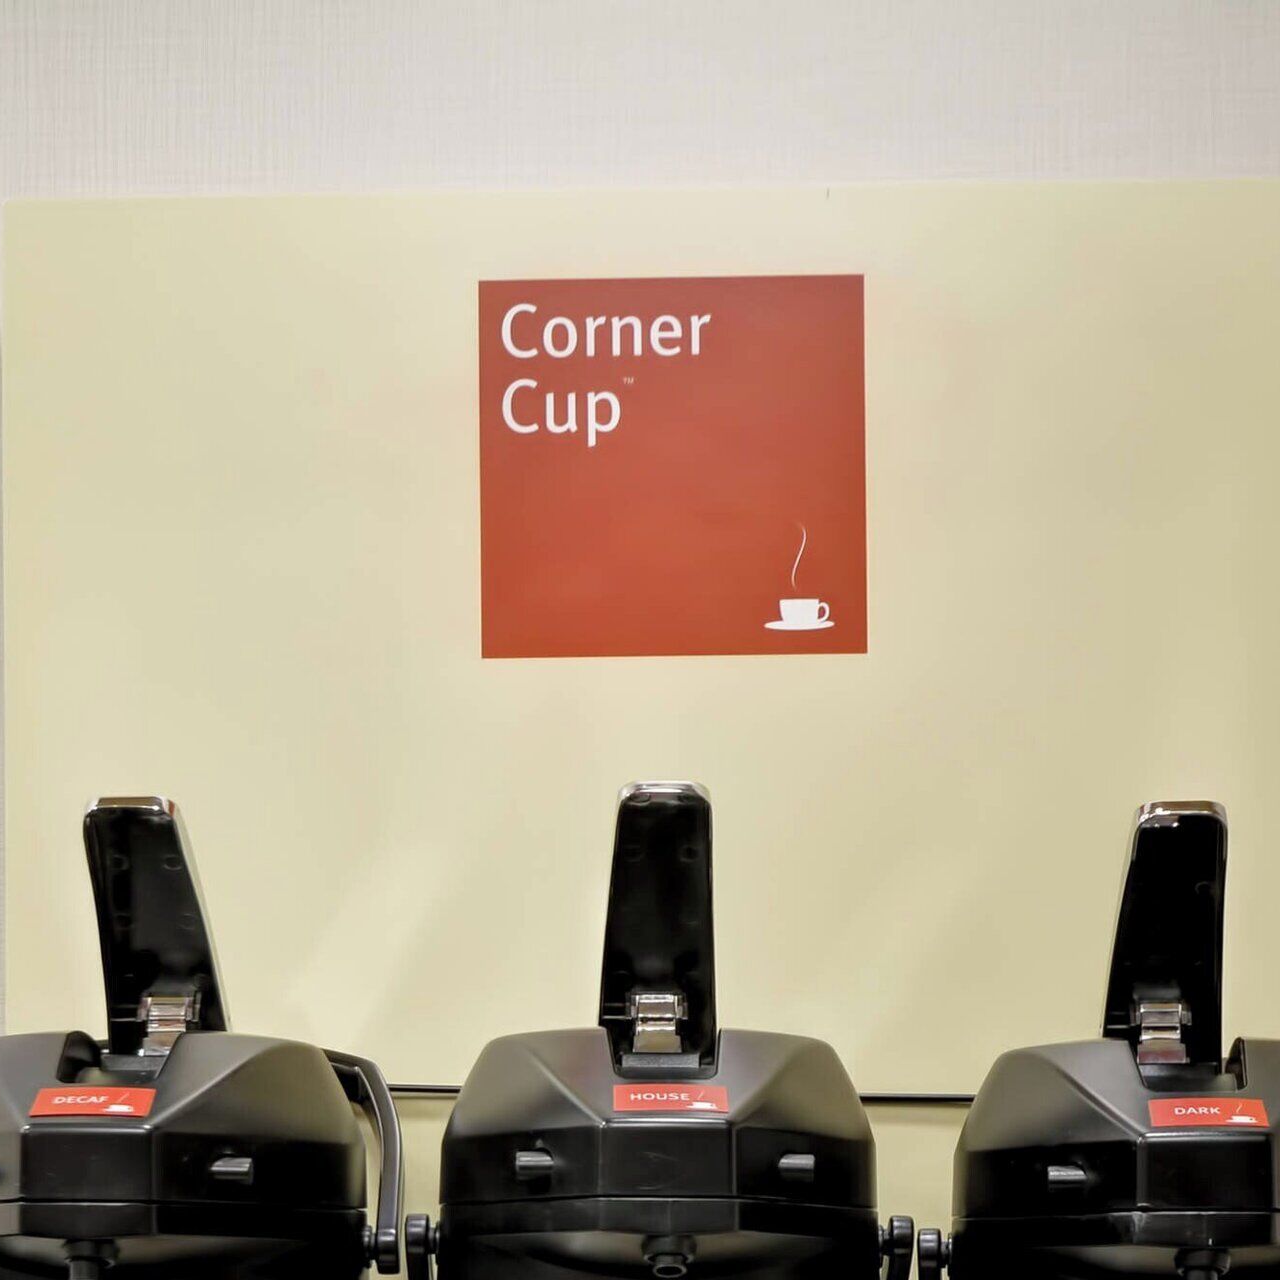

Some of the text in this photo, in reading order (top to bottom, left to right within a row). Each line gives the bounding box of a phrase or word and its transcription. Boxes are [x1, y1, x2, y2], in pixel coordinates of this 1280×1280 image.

[500, 303, 712, 359] Corner
[501, 378, 622, 448] Cup
[52, 1095, 109, 1104] DECAF
[630, 1092, 690, 1101] HOUSE
[1173, 1106, 1221, 1115] DARK
